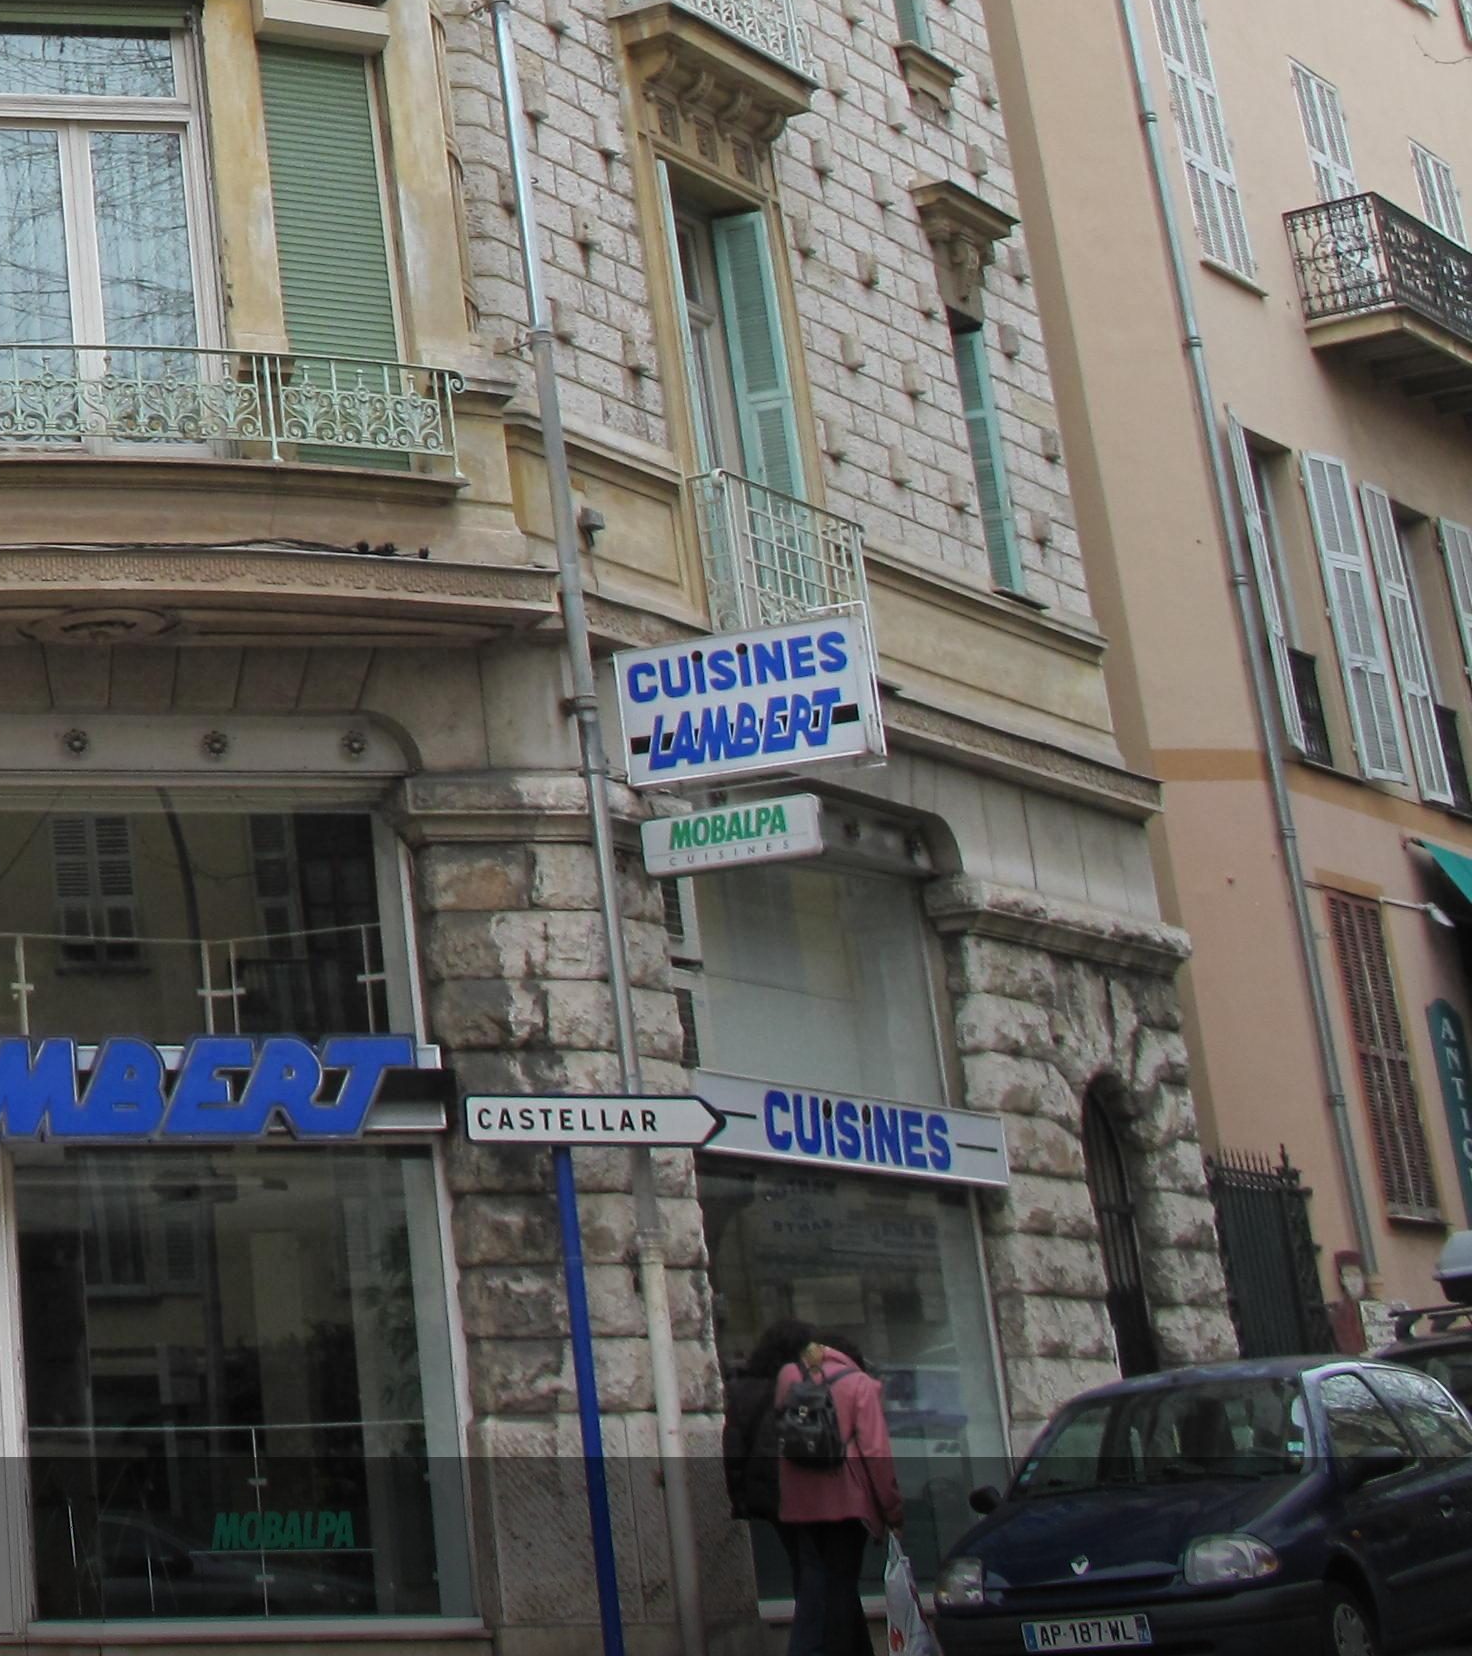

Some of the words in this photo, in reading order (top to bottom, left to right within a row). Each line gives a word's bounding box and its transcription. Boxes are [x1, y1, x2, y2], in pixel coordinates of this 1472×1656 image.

[648, 687, 842, 771] LAMBERT
[670, 804, 787, 851] MOBALPA
[669, 840, 790, 867] CUISINES
[478, 1107, 657, 1132] CASTELLAR
[212, 1510, 356, 1550] MOBALPA
